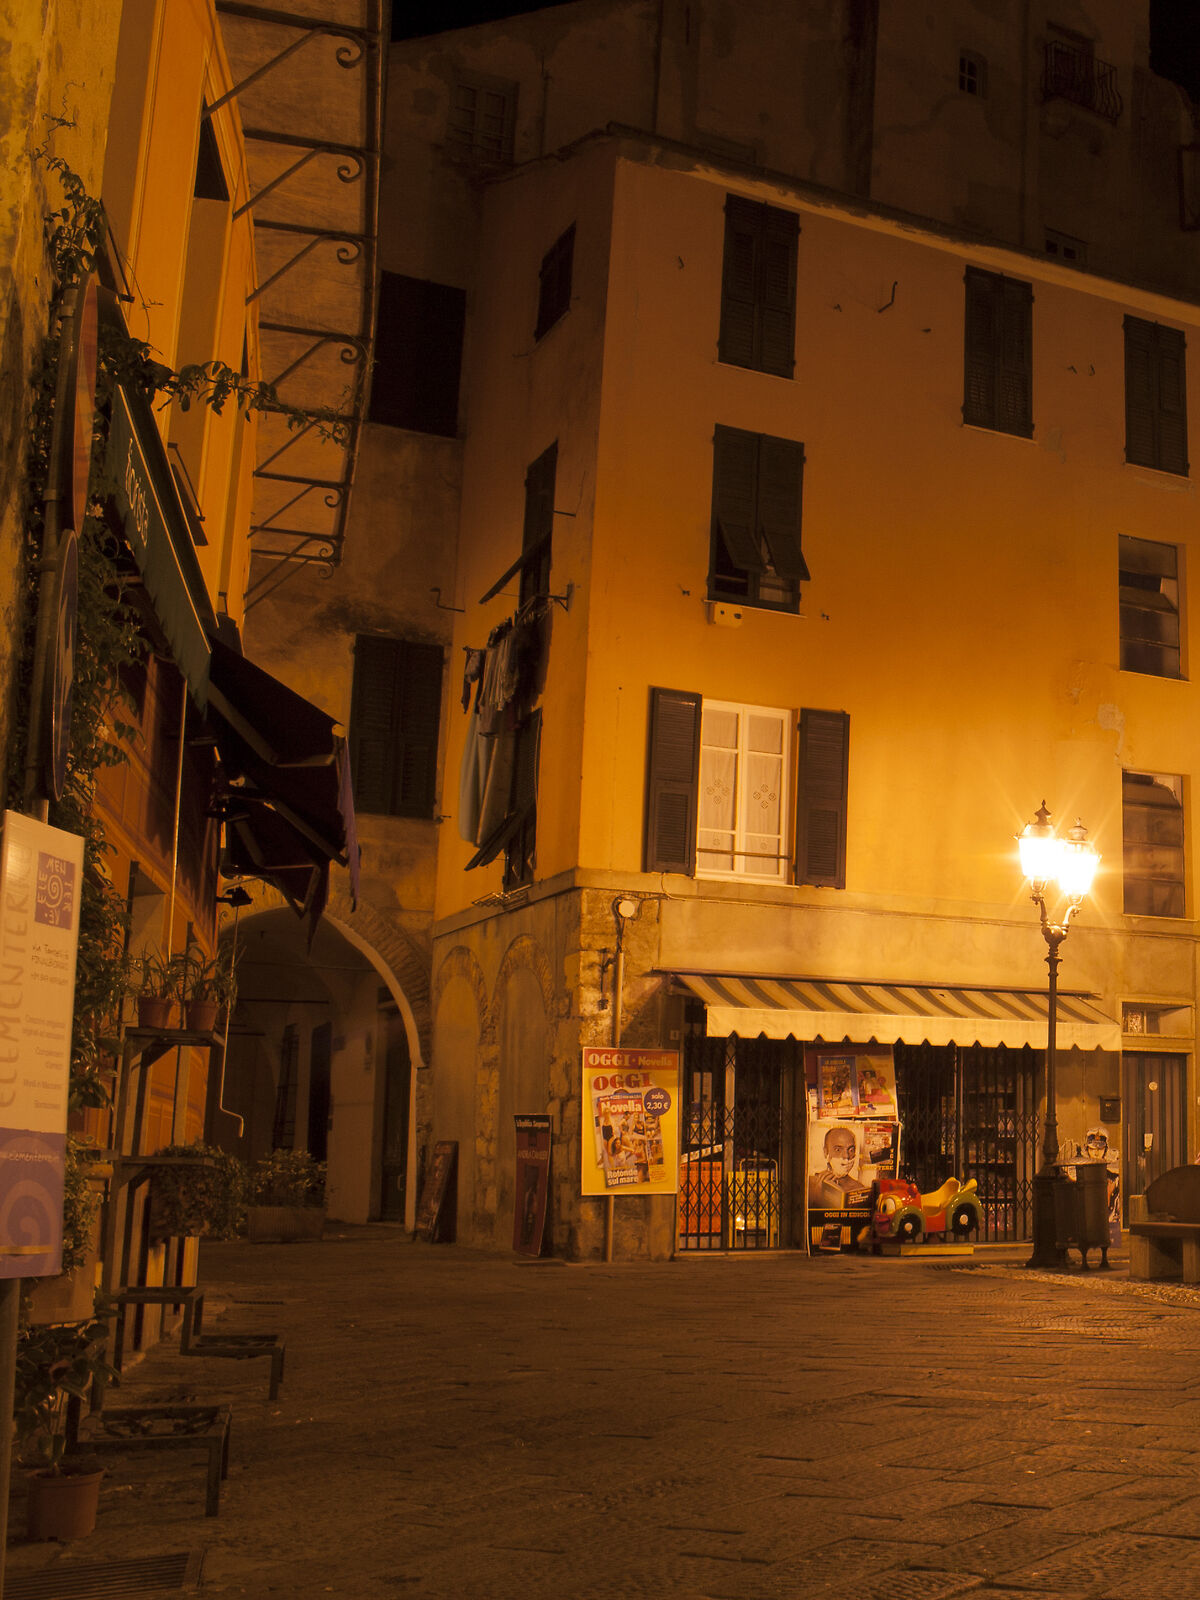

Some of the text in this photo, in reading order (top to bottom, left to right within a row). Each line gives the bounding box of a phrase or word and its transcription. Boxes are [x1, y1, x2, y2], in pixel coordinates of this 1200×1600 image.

[587, 1052, 673, 1067] OGGI Novella
[593, 1072, 652, 1091] OGGI
[650, 1091, 664, 1100] solo
[600, 1099, 642, 1114] Novella
[646, 1101, 669, 1111] 2,30 €
[607, 1175, 638, 1186] sul mare
